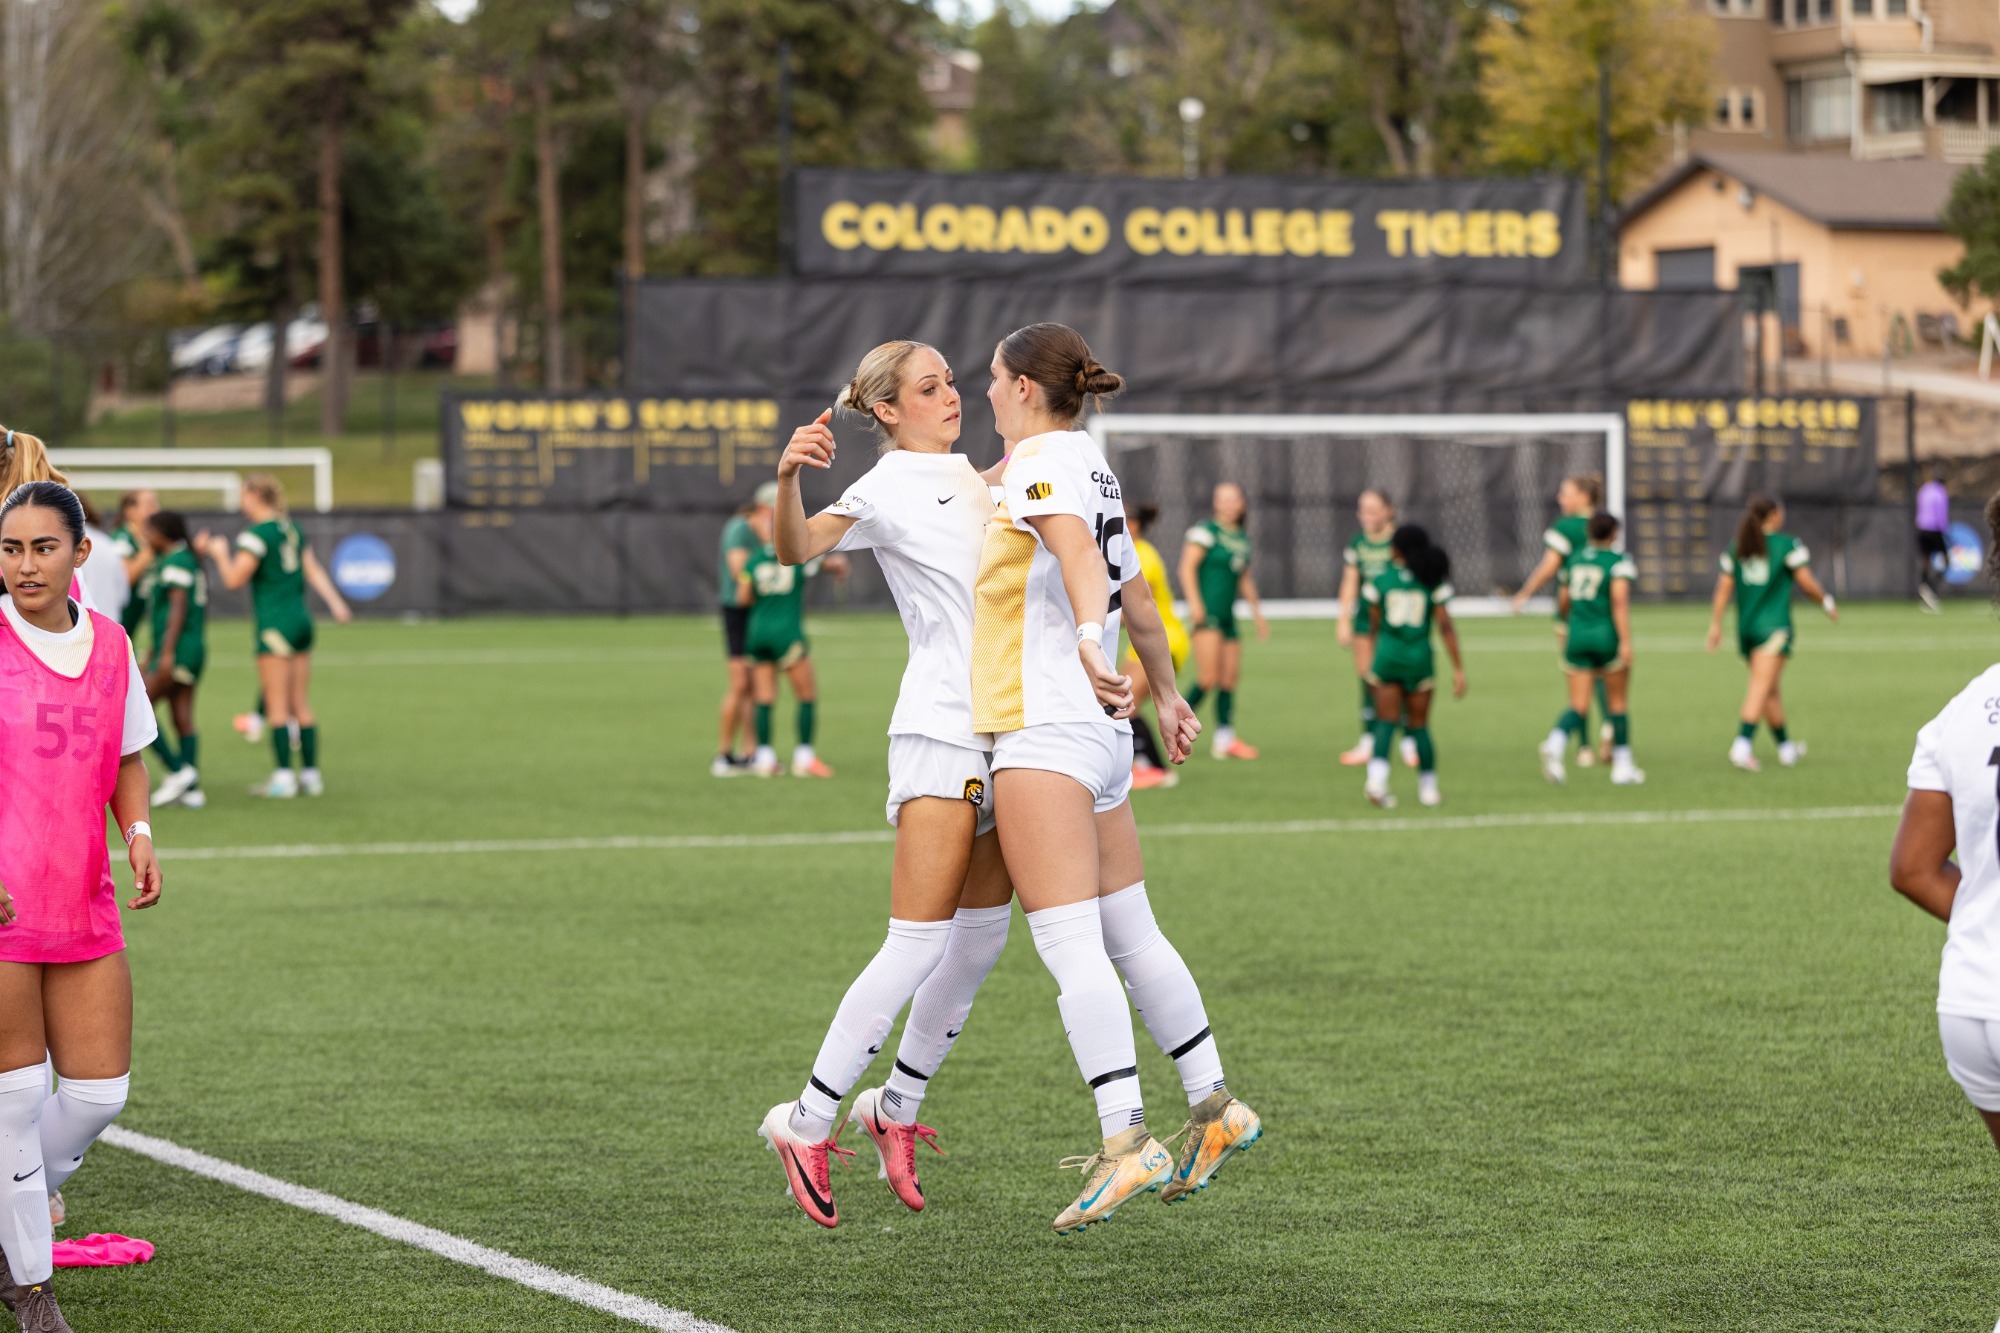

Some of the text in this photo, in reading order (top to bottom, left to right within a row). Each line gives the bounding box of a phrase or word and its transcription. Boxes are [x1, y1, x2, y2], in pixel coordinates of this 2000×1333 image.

[823, 202, 1562, 258] COLORADO COLLEGE TIGERS
[33, 703, 98, 760] 55
